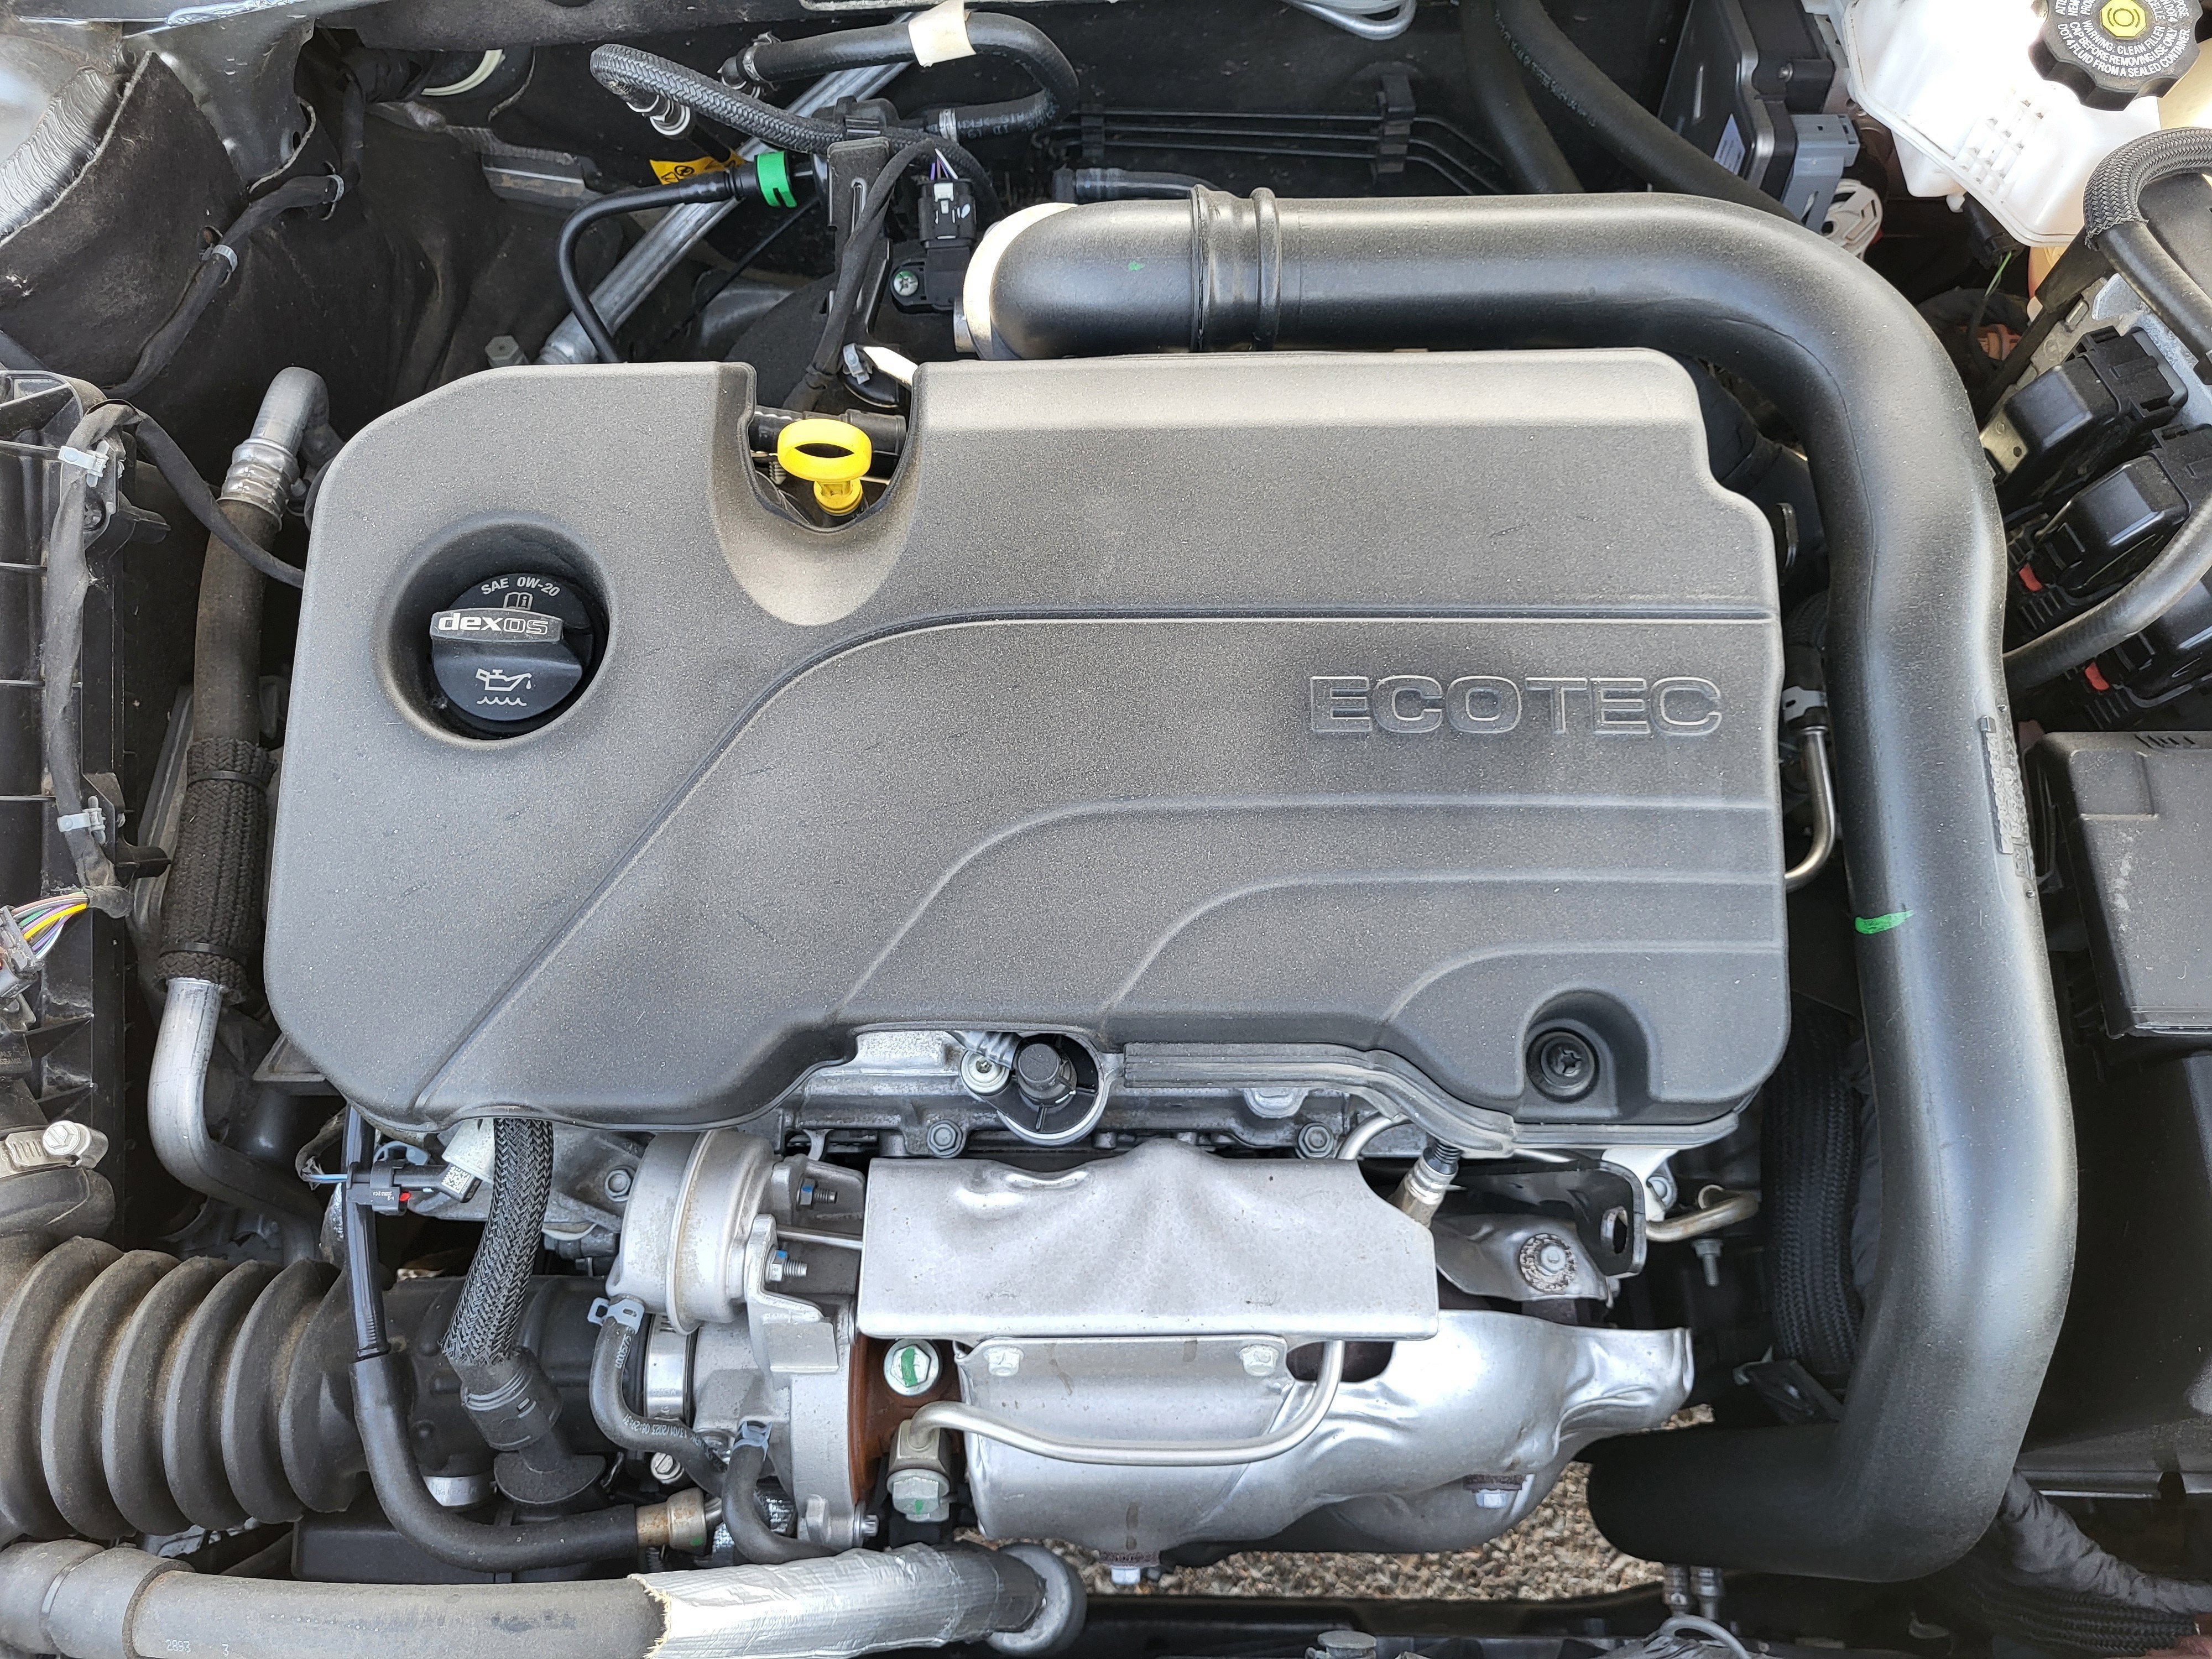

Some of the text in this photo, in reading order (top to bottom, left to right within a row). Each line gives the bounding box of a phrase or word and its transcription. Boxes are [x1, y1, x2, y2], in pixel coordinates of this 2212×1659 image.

[2057, 23, 2073, 40] DOT
[2069, 43, 2094, 64] FLUID
[2092, 59, 2119, 76] FROM
[2119, 67, 2127, 77] A
[2127, 62, 2162, 78] SEALED
[2159, 28, 2191, 68] CONTAINER.
[2069, 22, 2085, 38] CAP
[2078, 36, 2110, 61] BEFORE
[2154, 44, 2168, 59] USE
[2163, 27, 2178, 47] ONLY
[2082, 19, 2166, 55] WARNING: CLEAN FILLER
[481, 576, 561, 597] SAE 0W-20
[437, 612, 549, 635] dexos
[1310, 675, 1723, 735] ECOTEC
